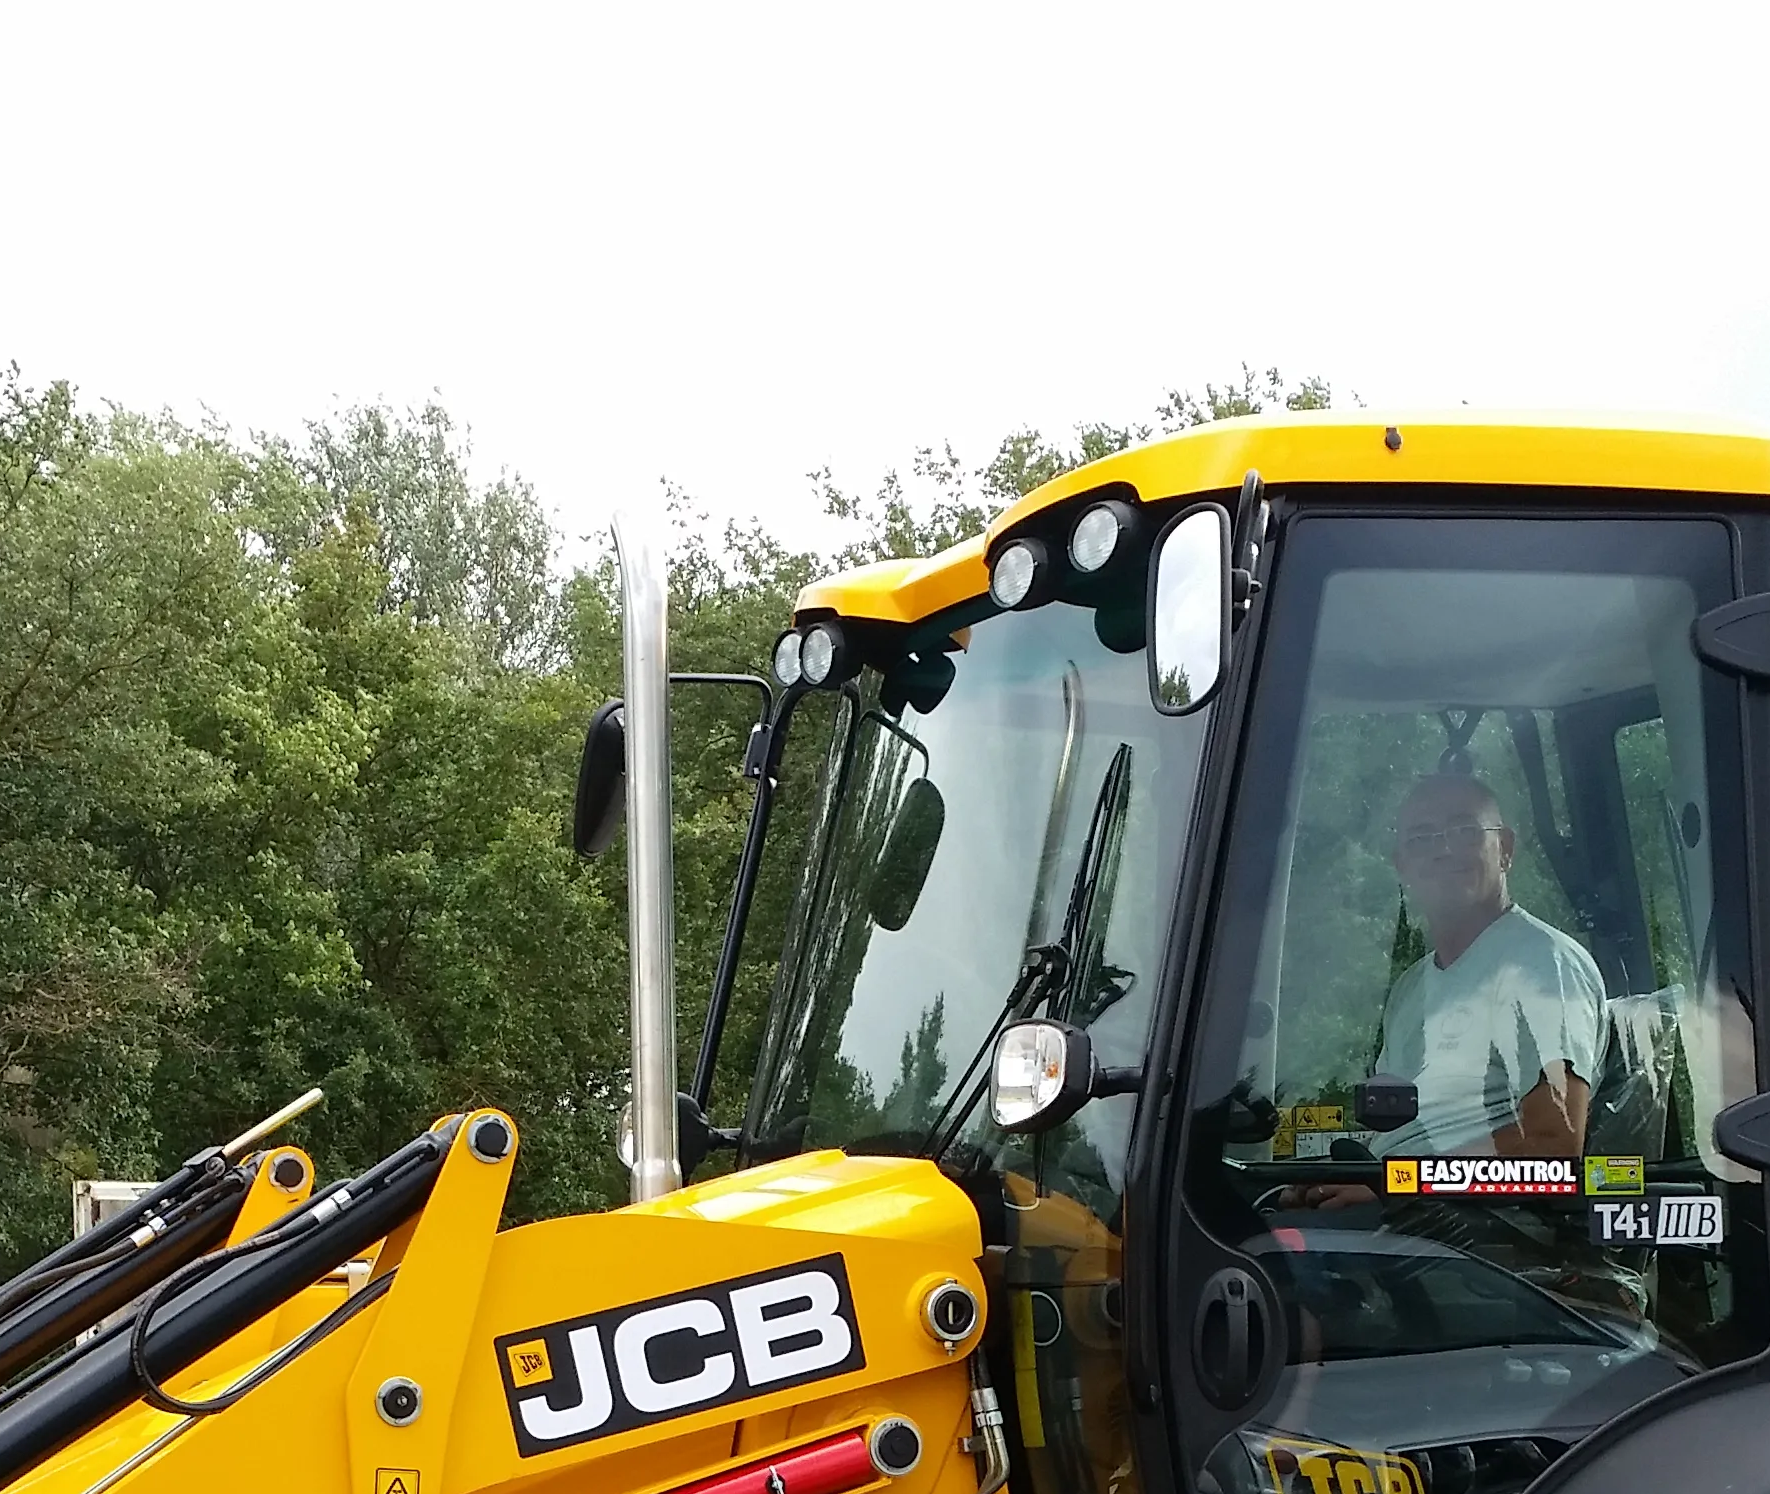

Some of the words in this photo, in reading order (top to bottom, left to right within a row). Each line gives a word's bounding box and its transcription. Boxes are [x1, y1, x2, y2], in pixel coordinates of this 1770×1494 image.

[1394, 1169, 1412, 1184] JCB
[1420, 1160, 1577, 1191] EASYCONTROL
[1473, 1184, 1573, 1192] ADVANCED
[1593, 1203, 1654, 1239] T4i
[518, 1270, 853, 1441] JCB
[519, 1354, 543, 1373] JCB
